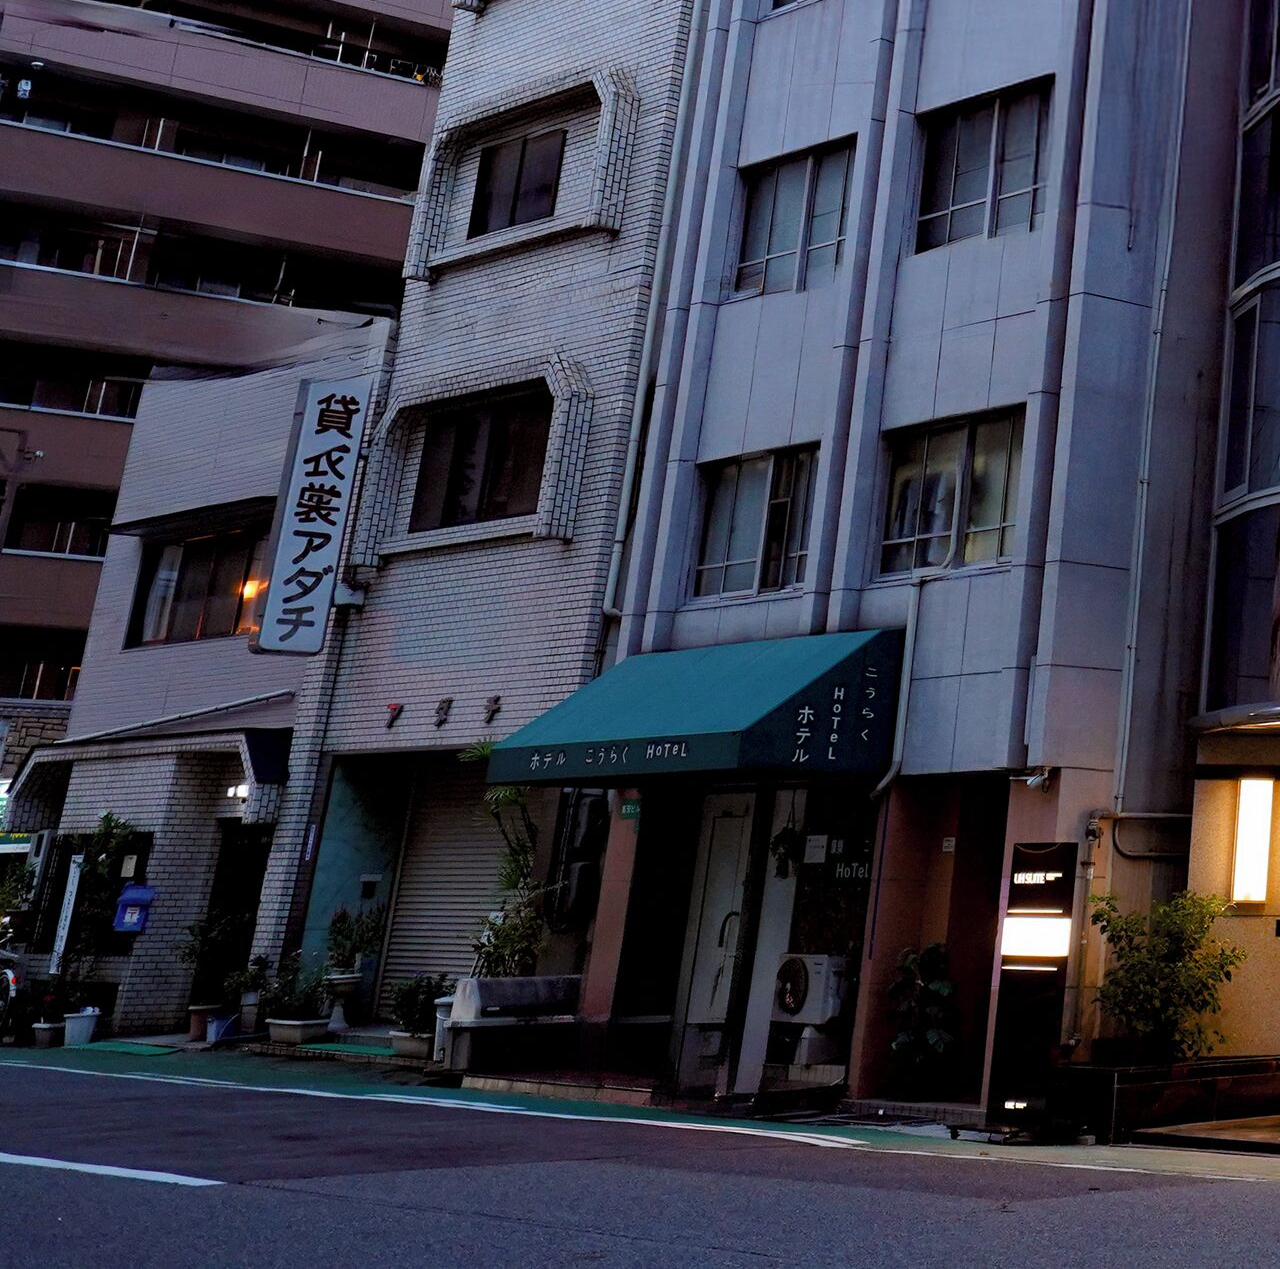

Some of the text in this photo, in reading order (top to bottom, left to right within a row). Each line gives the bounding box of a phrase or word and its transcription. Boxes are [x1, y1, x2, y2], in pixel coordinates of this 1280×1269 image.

[275, 392, 361, 643] 貸衣裳アダチ
[791, 705, 815, 763] ホテル
[861, 666, 879, 742] こうらく
[529, 752, 567, 771] ホテル
[584, 746, 629, 765] こうらく
